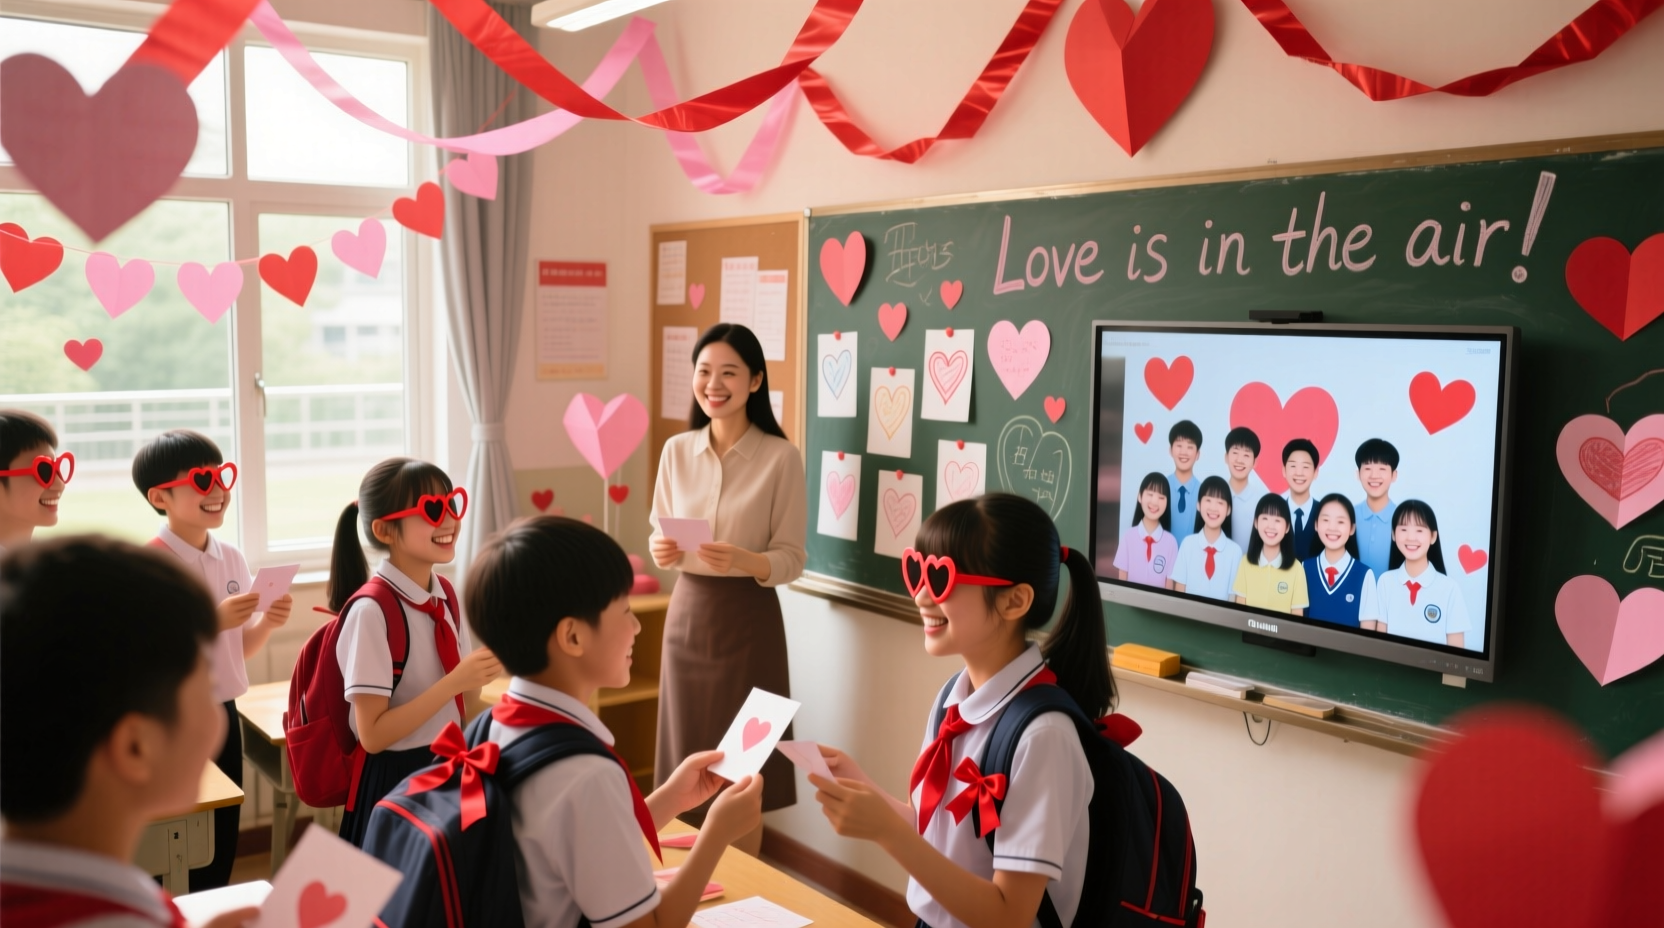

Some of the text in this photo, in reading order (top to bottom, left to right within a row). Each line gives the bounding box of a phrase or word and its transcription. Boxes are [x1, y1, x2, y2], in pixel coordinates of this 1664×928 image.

[993, 214, 1104, 296] Love
[1126, 225, 1168, 283] is
[1198, 219, 1251, 277] in
[1272, 191, 1377, 276] the
[1405, 171, 1557, 284] air!
